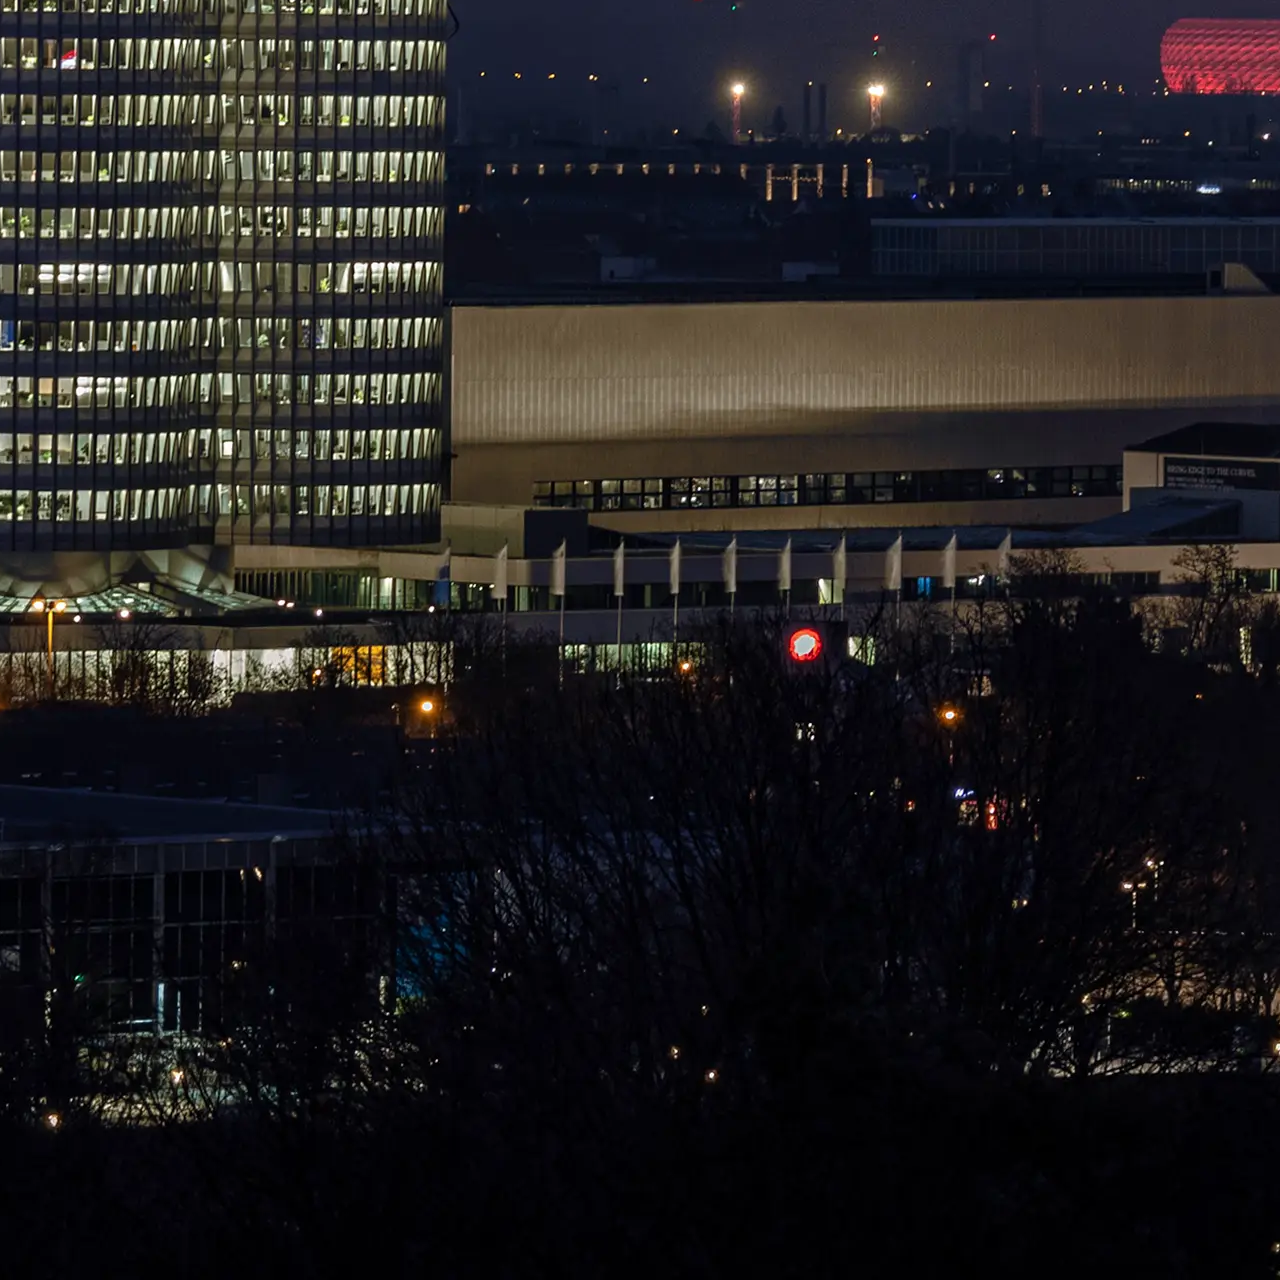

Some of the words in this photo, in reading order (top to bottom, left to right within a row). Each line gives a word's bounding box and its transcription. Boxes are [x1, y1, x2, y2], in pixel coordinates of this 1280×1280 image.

[1188, 466, 1204, 475] EDGE
[1206, 466, 1216, 476] TO
[1216, 467, 1228, 476] THE
